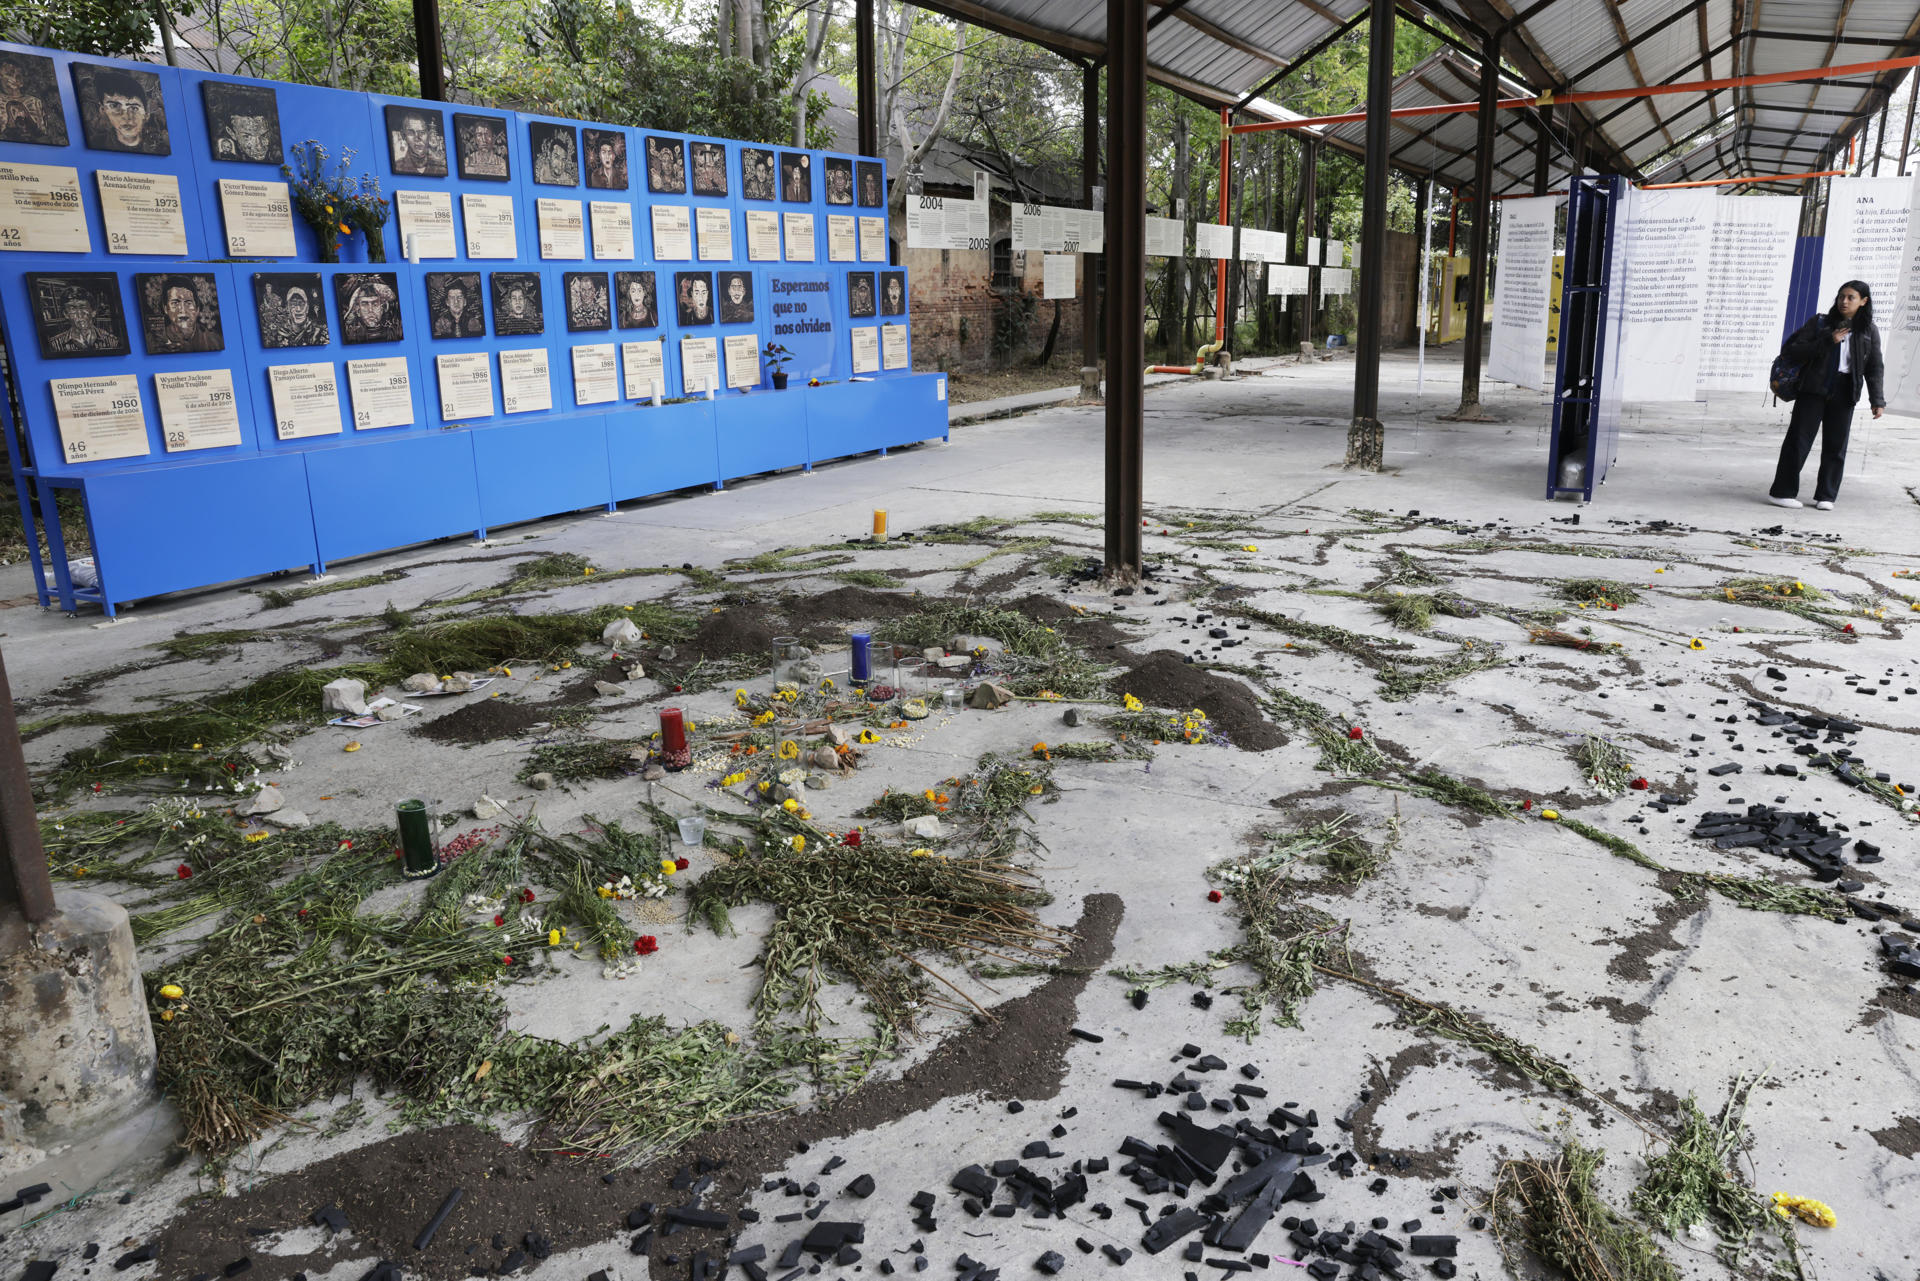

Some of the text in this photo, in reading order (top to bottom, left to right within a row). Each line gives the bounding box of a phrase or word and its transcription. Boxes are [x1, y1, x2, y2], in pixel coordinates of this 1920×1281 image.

[123, 176, 154, 184] Alexander
[50, 192, 78, 201] 1966
[155, 198, 178, 208] 1973
[920, 196, 943, 210] 2004
[267, 204, 288, 212] 1985
[1024, 203, 1041, 216] 2006
[0, 228, 20, 240] 42
[112, 233, 127, 244] 34
[232, 237, 246, 246] 23
[470, 242, 480, 250] 36
[969, 238, 989, 250] 2005
[1064, 241, 1079, 252] 2007
[772, 279, 829, 295] Esperamos
[773, 302, 807, 317] que no
[775, 318, 831, 335] nos olviden
[389, 377, 407, 385] 1983
[58, 382, 82, 390] Olimpo
[314, 384, 334, 392] 1982
[209, 392, 231, 401] 1978
[112, 399, 138, 409] 1960
[506, 398, 516, 406] 26
[445, 404, 454, 412] 21
[358, 412, 370, 421] 24
[280, 421, 294, 430] 26
[169, 432, 185, 442] 28
[69, 441, 86, 452] 46
